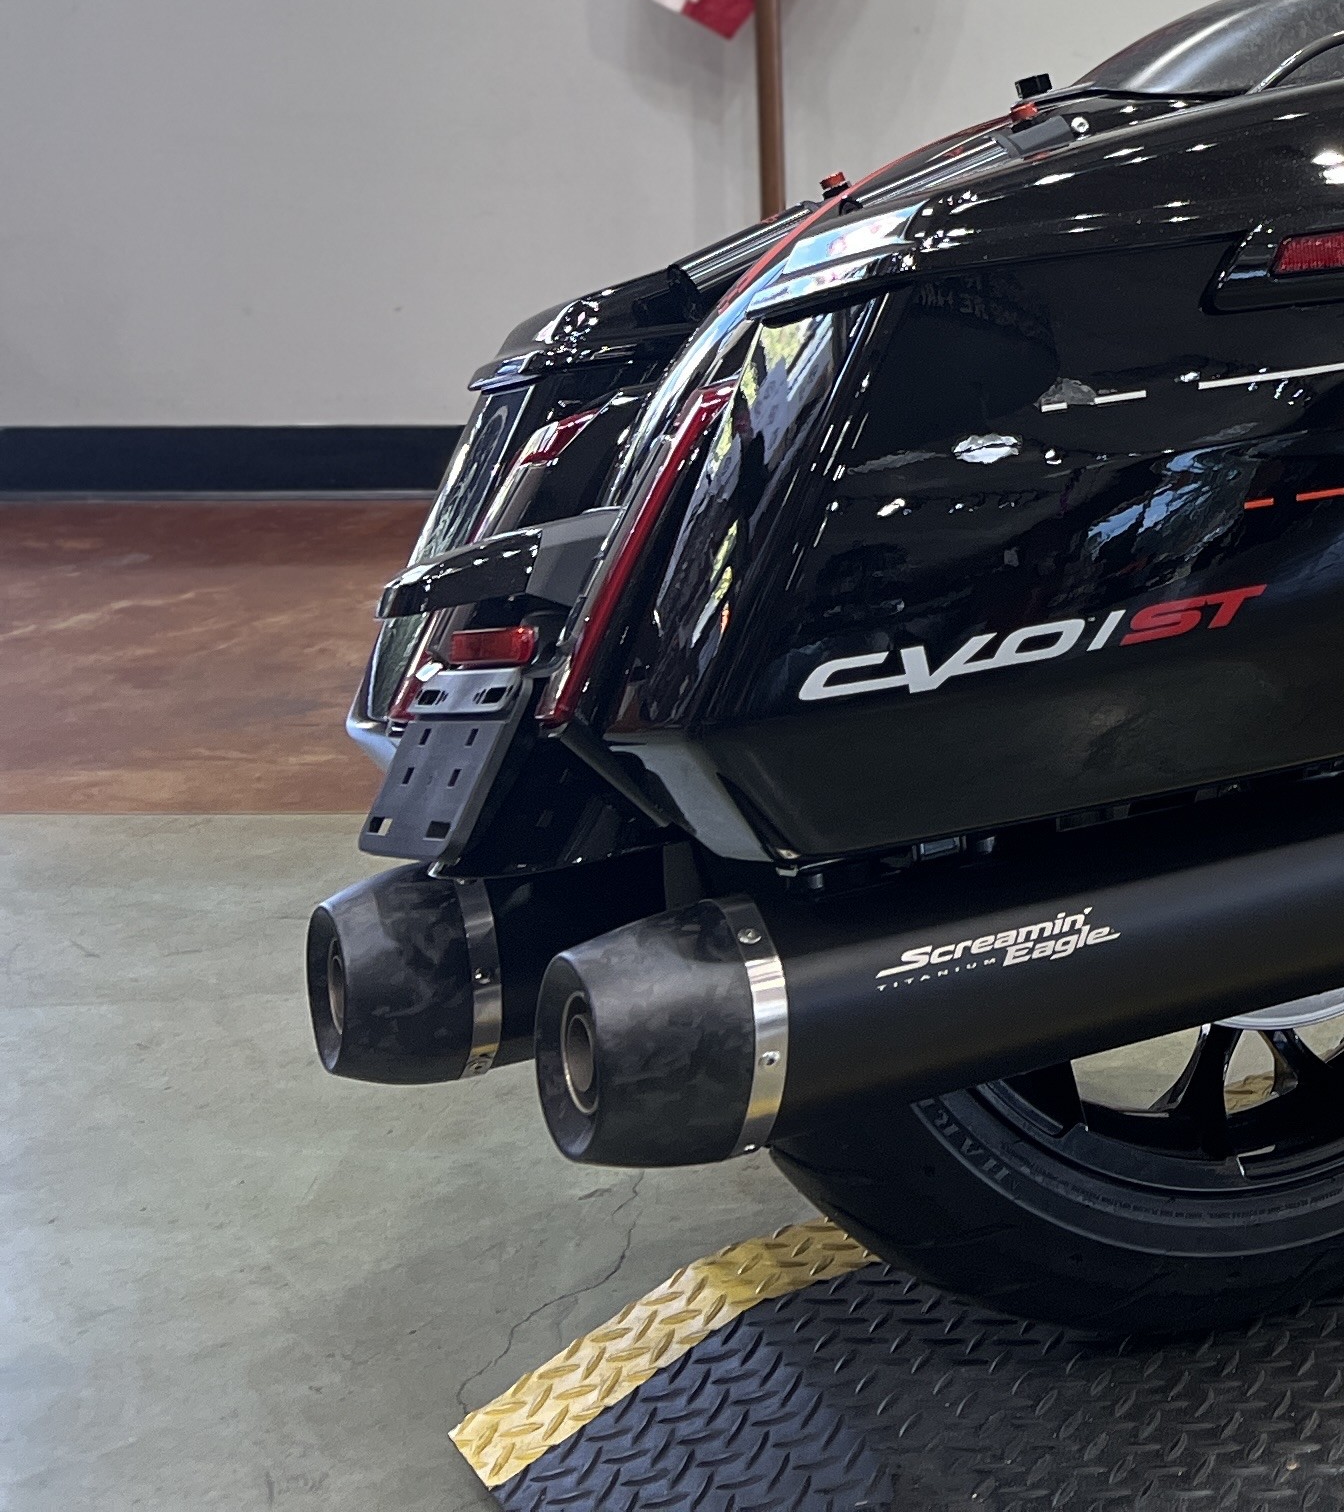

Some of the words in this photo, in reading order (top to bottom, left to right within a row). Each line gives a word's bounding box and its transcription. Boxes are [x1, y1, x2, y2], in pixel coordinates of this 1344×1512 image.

[875, 906, 1093, 979] Screamin'
[1002, 924, 1121, 967] Eagle
[876, 957, 997, 992] TITANIUM
